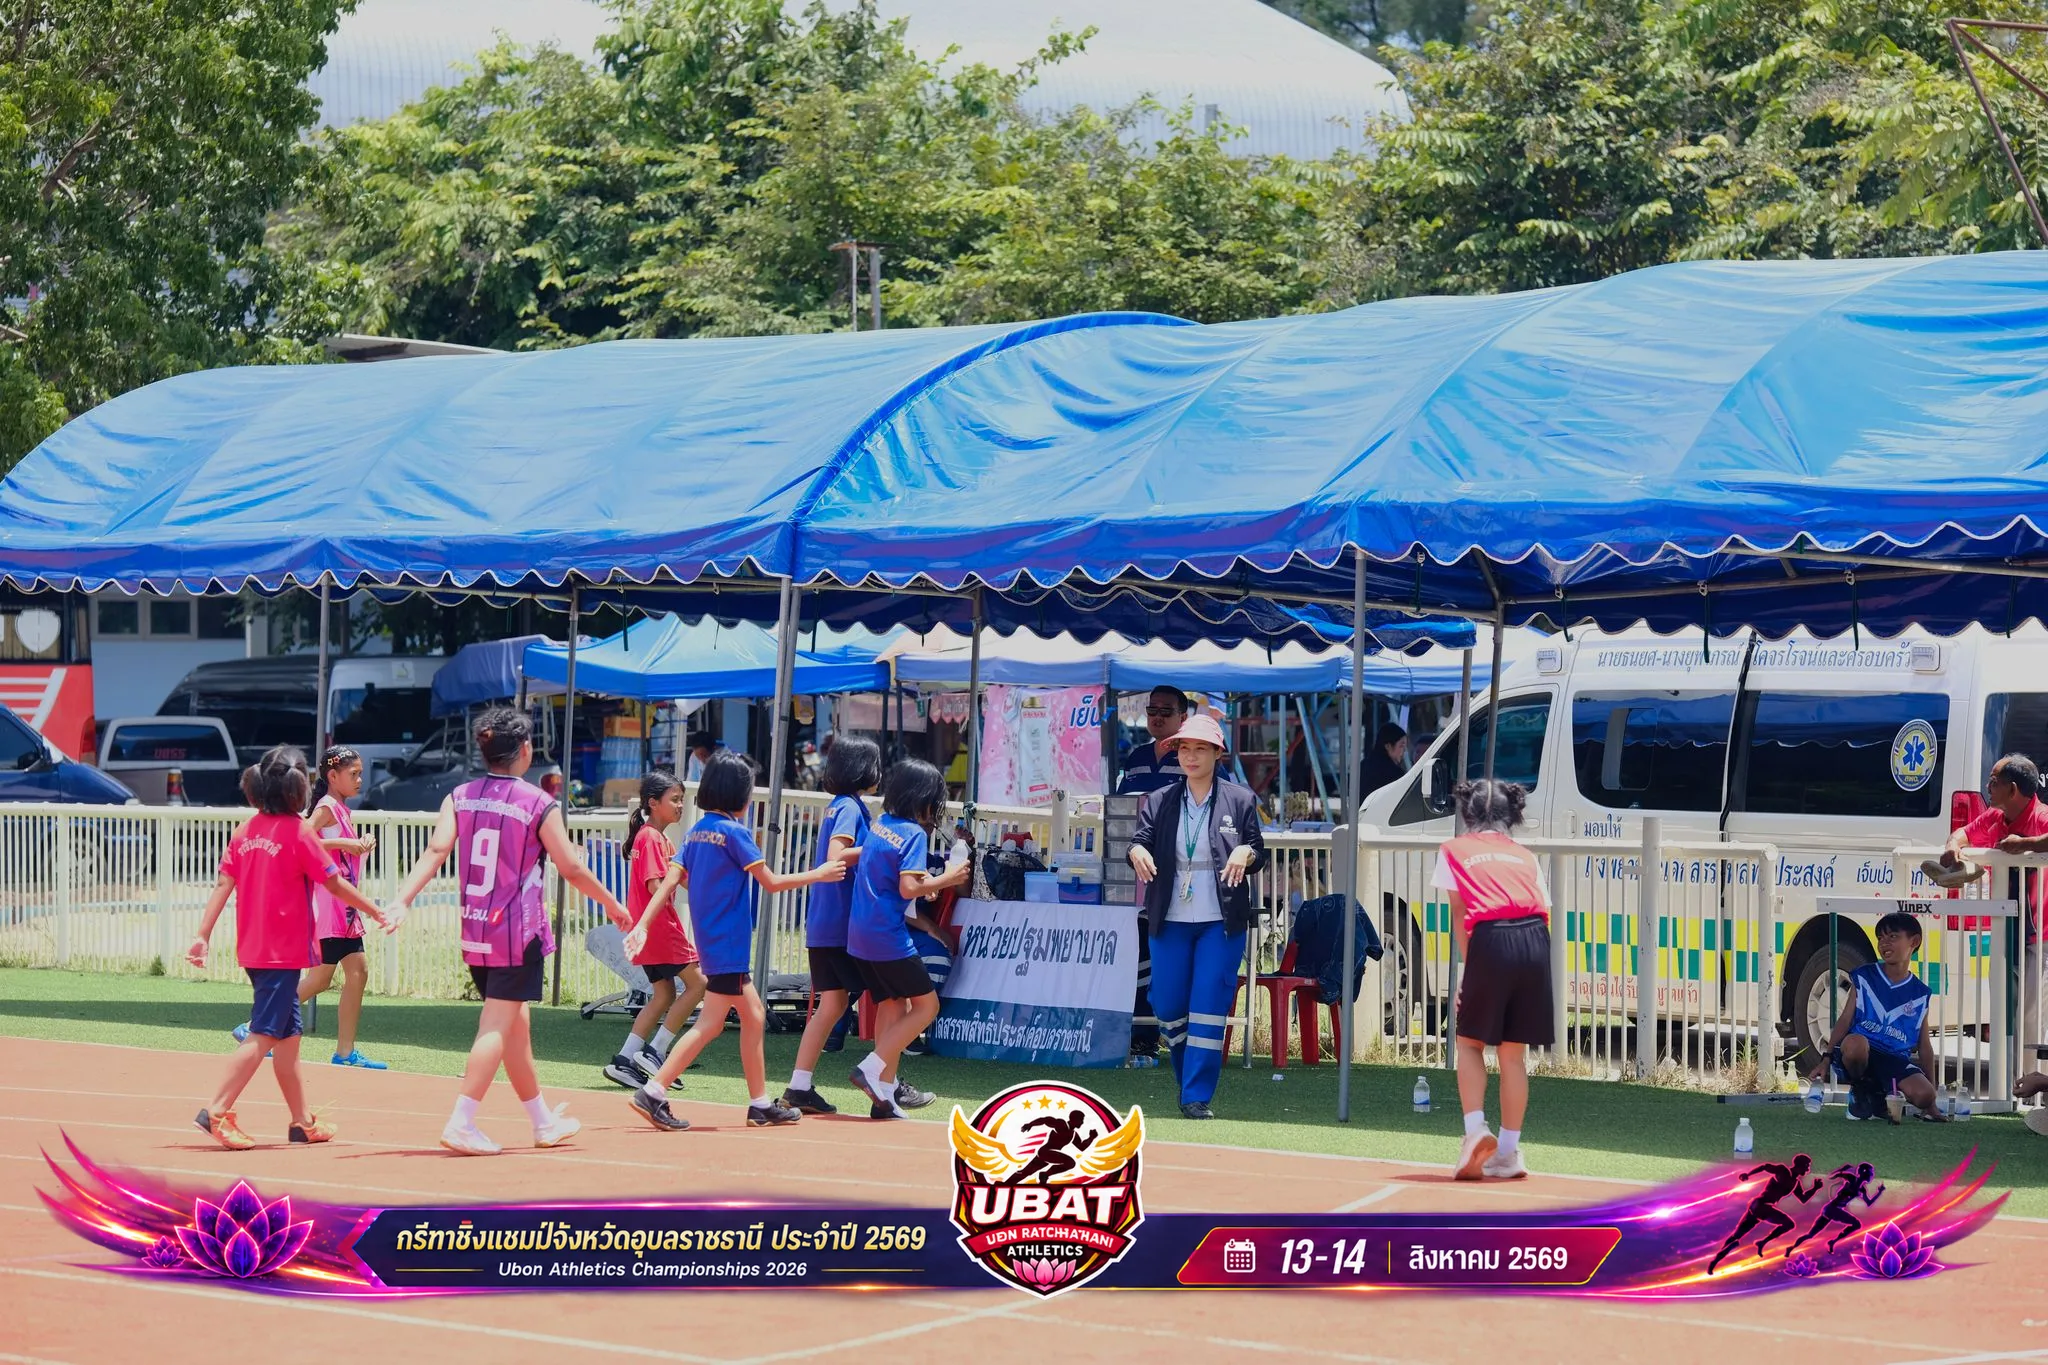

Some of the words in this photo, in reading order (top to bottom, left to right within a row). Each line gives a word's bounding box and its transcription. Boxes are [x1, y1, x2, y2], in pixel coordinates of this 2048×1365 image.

[1584, 813, 1623, 838] มอบให้
[465, 828, 501, 897] 9
[1897, 900, 1932, 914] Vinex
[962, 911, 1118, 977] หน่วยปฐมพยาบาล
